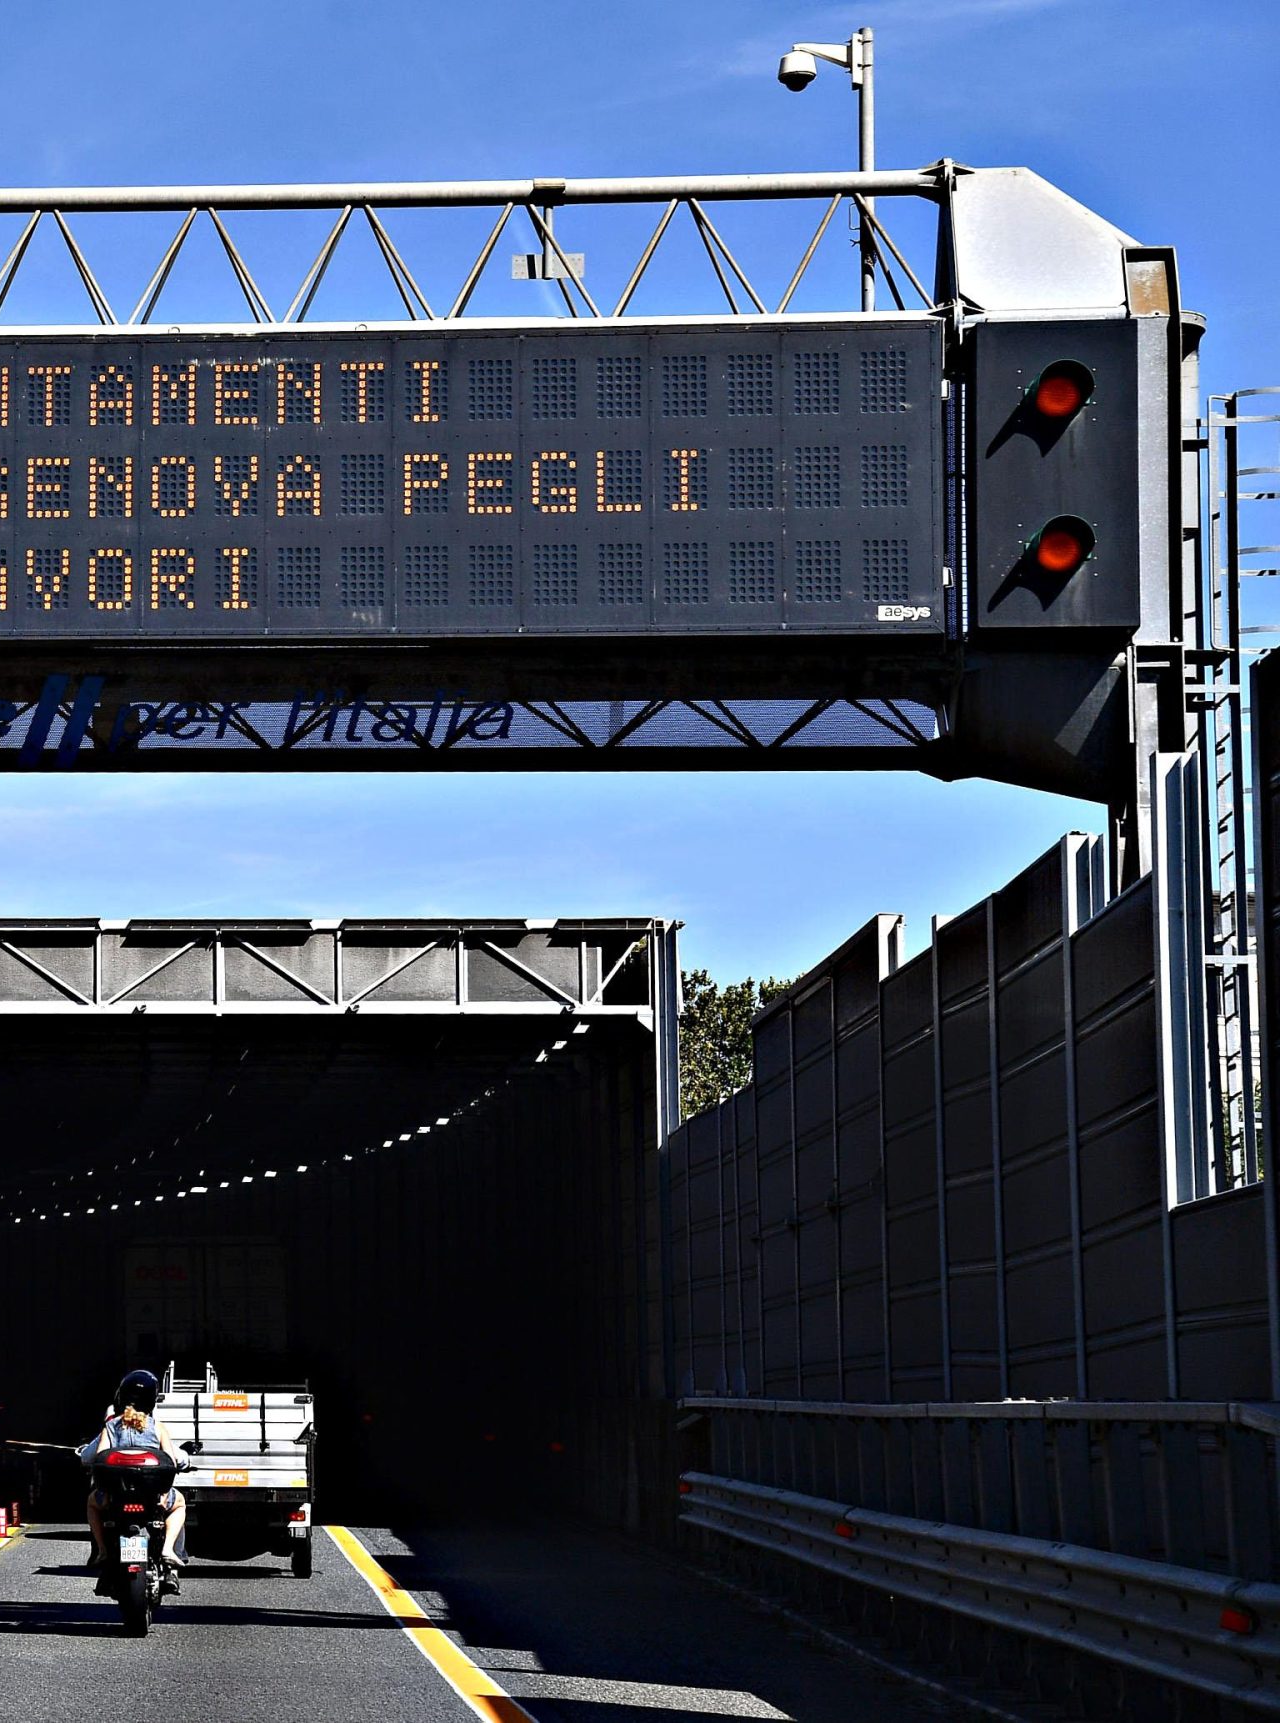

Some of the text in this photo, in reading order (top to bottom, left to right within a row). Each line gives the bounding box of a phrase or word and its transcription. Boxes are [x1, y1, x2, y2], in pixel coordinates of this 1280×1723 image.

[403, 449, 699, 514] PEGLI
[881, 605, 931, 621] aesys
[108, 699, 252, 753] per
[214, 1398, 245, 1408] STIHL
[215, 1472, 246, 1482] STIHL
